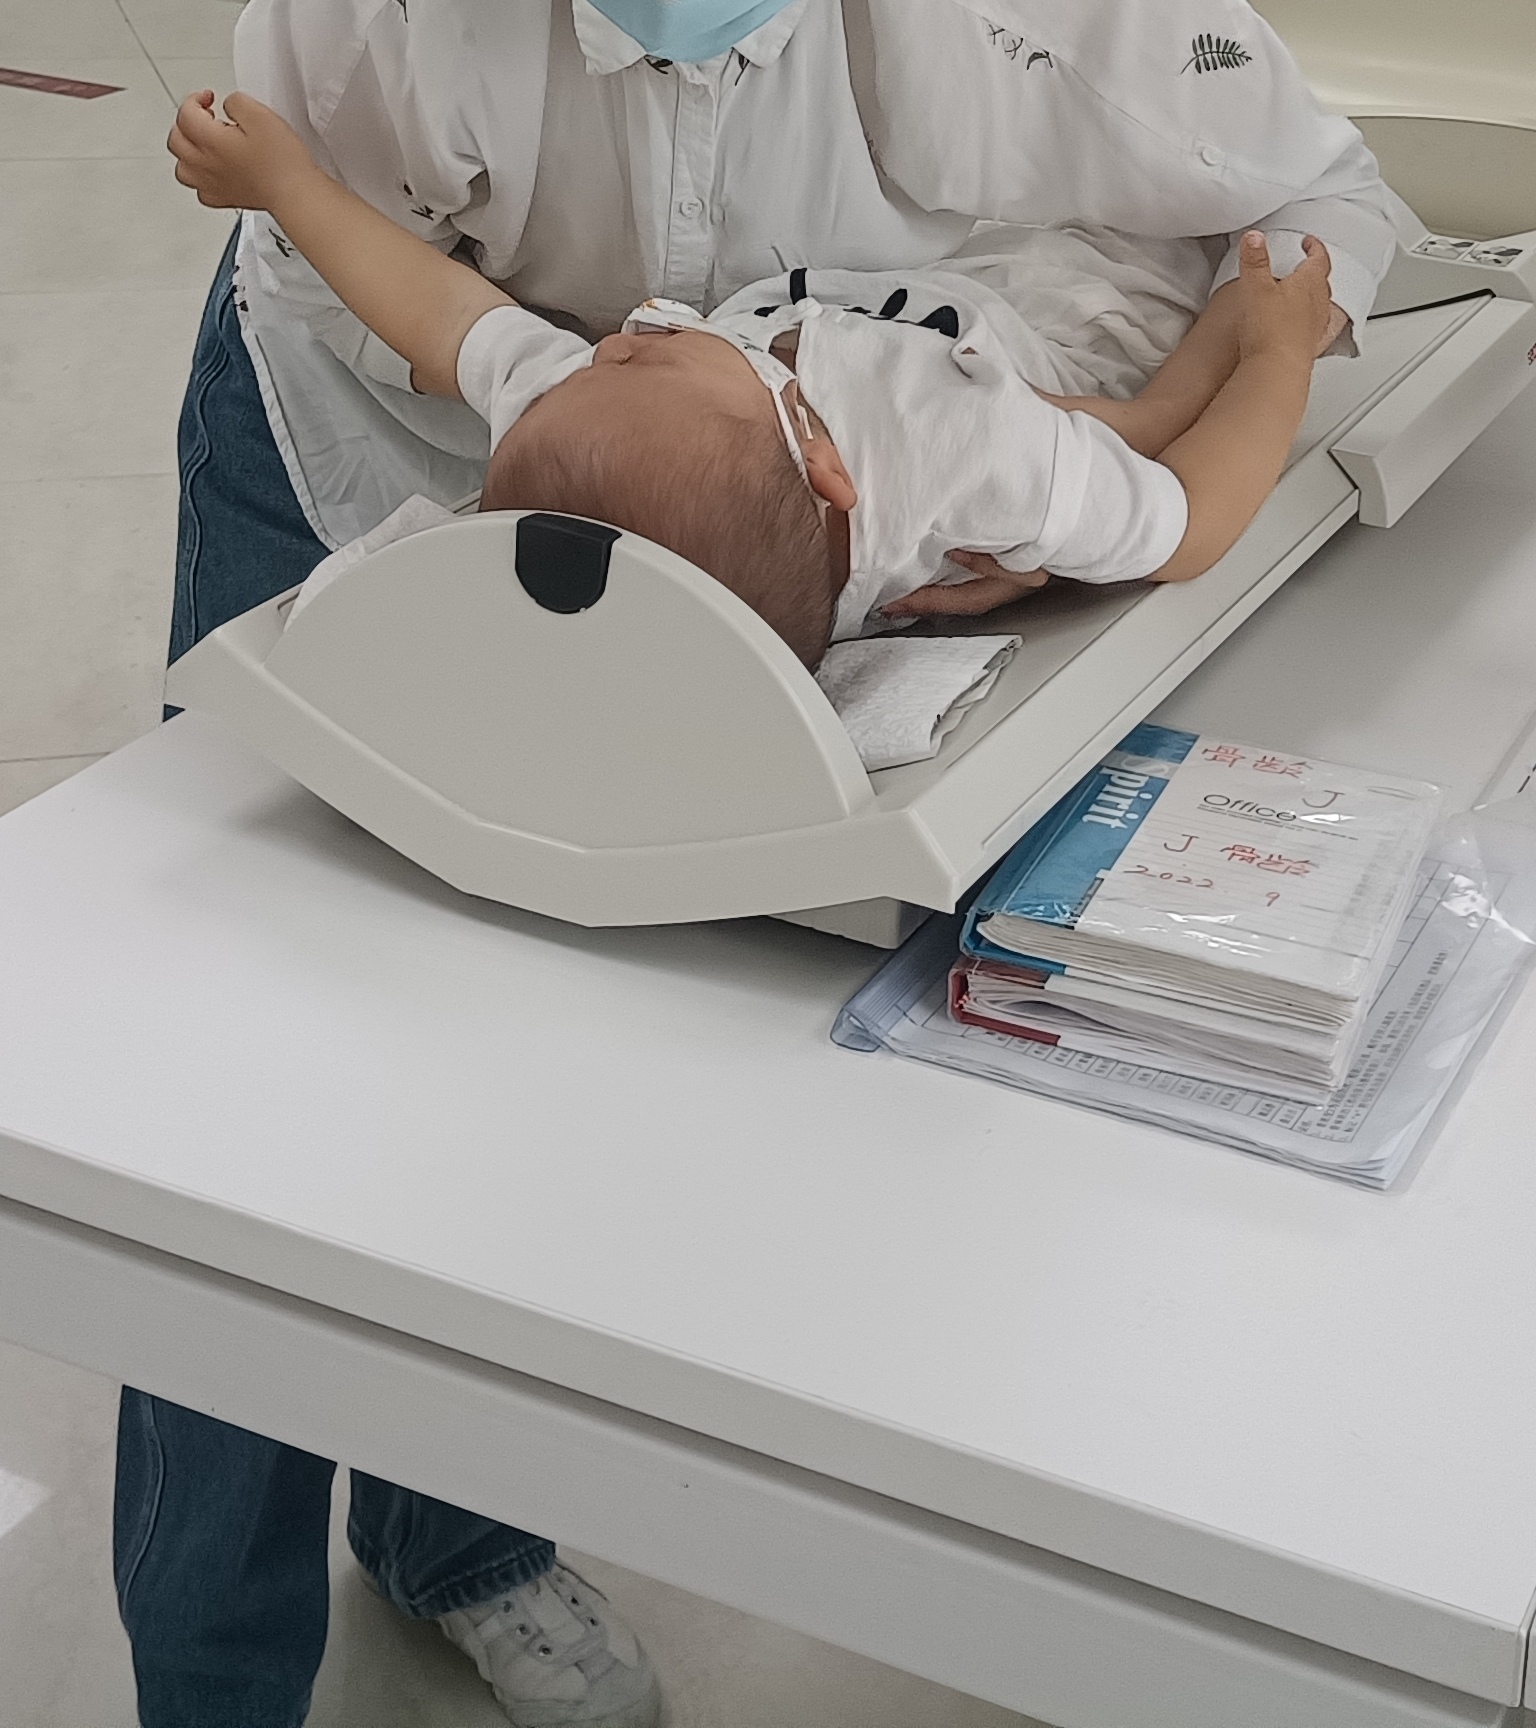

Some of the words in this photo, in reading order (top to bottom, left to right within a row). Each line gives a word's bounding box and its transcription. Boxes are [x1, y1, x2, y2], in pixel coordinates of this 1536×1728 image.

[1203, 794, 1297, 822] Office
[1123, 865, 1214, 889] 2022
[1265, 892, 1280, 907] 9
